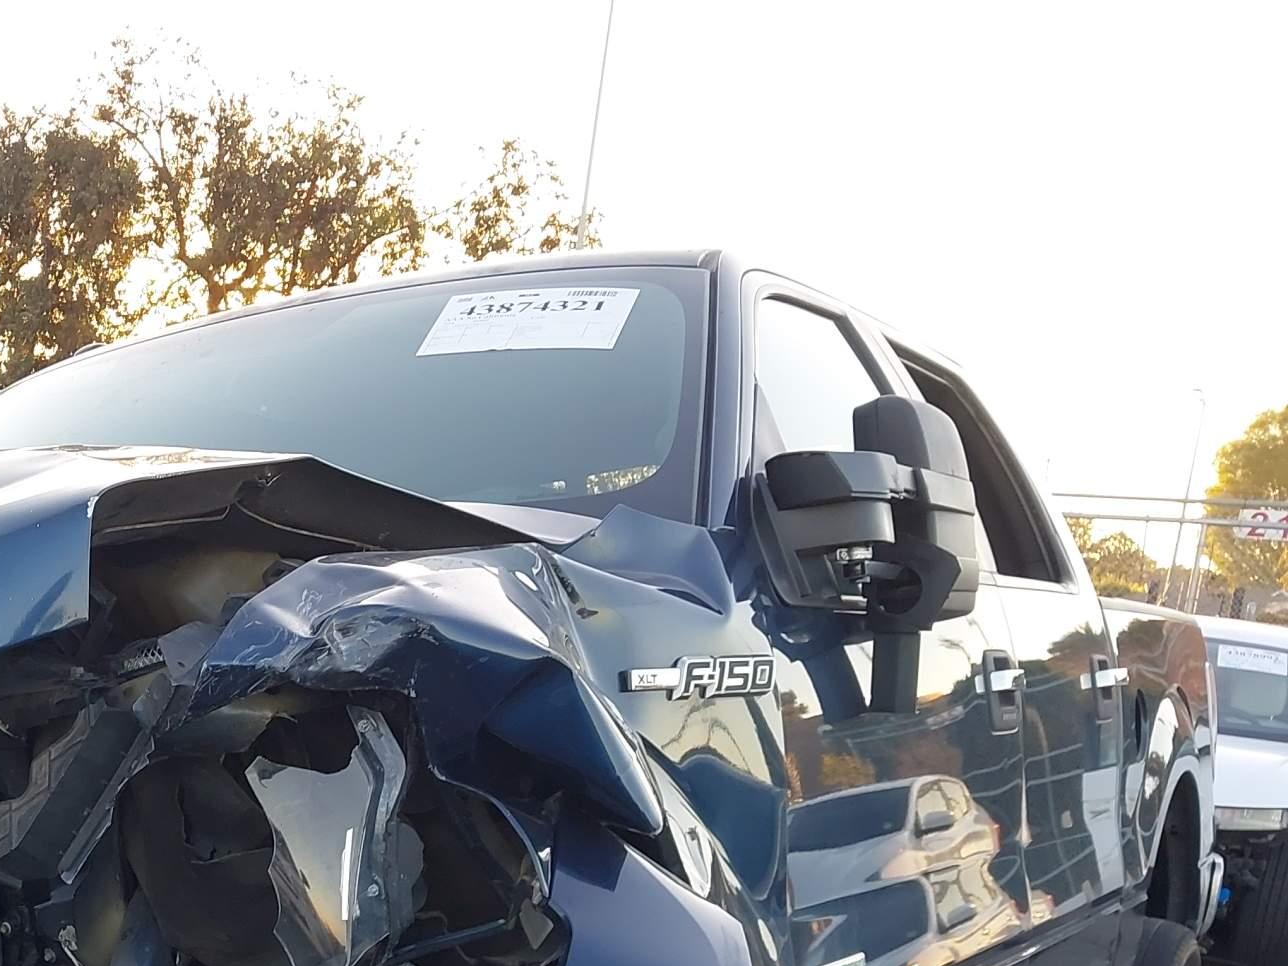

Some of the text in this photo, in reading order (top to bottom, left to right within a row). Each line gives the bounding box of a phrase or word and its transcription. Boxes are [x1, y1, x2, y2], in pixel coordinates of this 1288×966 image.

[460, 300, 605, 316] 43874321
[638, 658, 775, 697] XLT F-150
